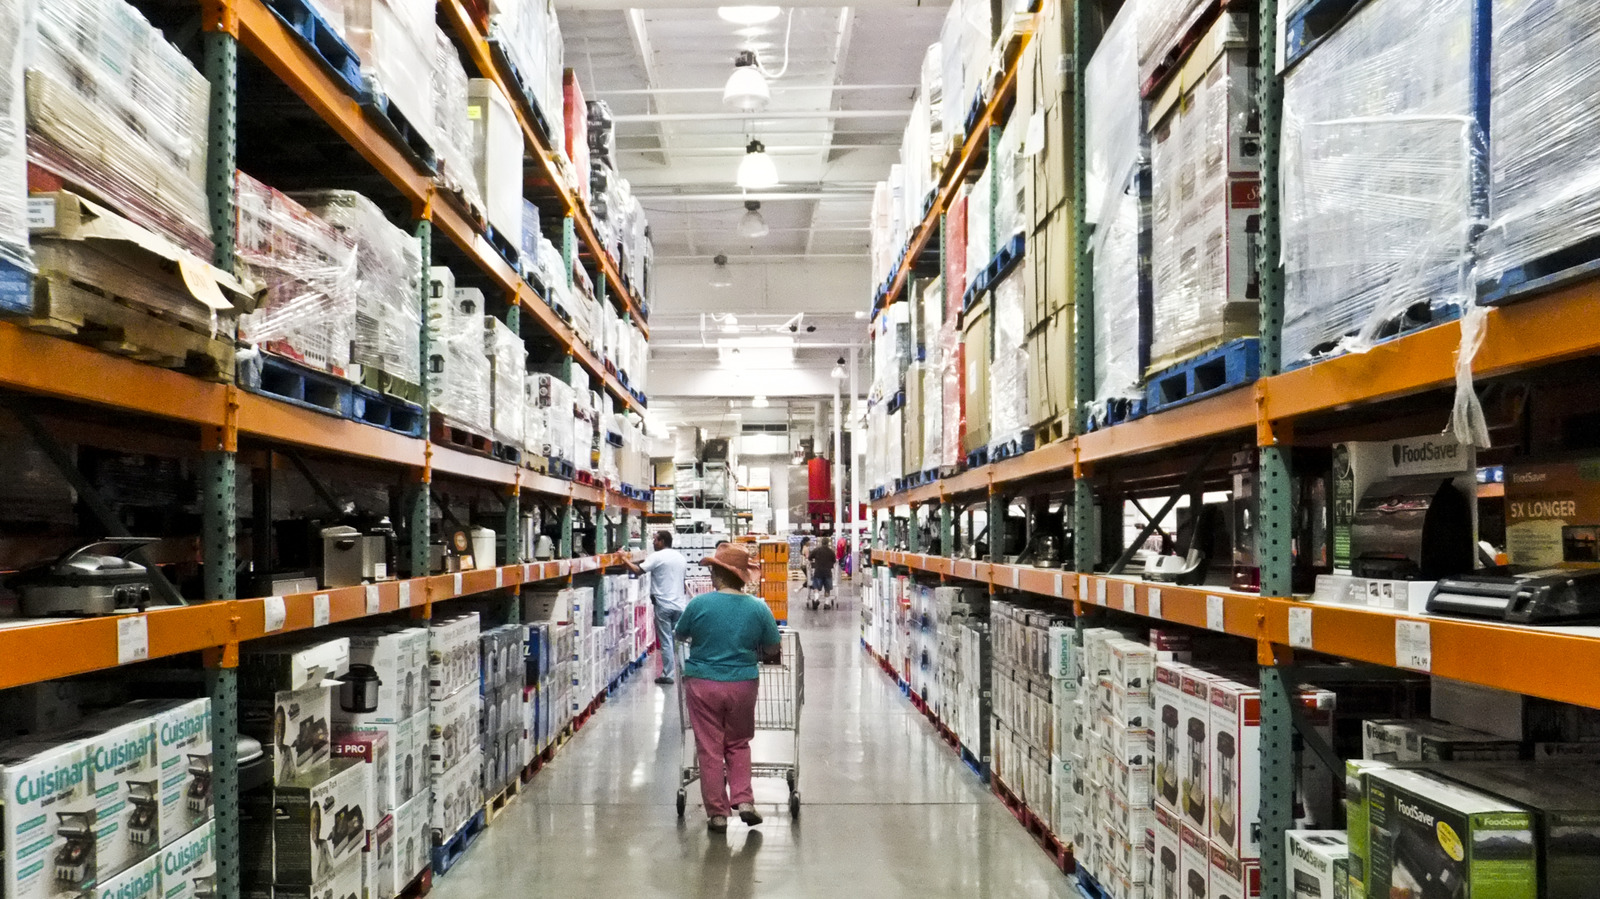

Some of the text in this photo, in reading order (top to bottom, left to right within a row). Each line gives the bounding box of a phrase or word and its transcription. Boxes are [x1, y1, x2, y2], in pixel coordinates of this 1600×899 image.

[1402, 442, 1459, 463] FoodSaver
[1512, 472, 1547, 484] FoodSaver
[1528, 500, 1577, 518] LONGER
[1060, 633, 1068, 676] Cuisinart
[160, 711, 212, 747] Cuisinart
[1371, 726, 1402, 747] FoodSaver
[95, 732, 157, 773] Cuisinart
[344, 744, 366, 754] PRO
[15, 756, 95, 805] Cuisinart
[1398, 799, 1434, 828] FoodSaver
[164, 827, 215, 876] Cuisinart
[1295, 841, 1328, 874] FoodSaver
